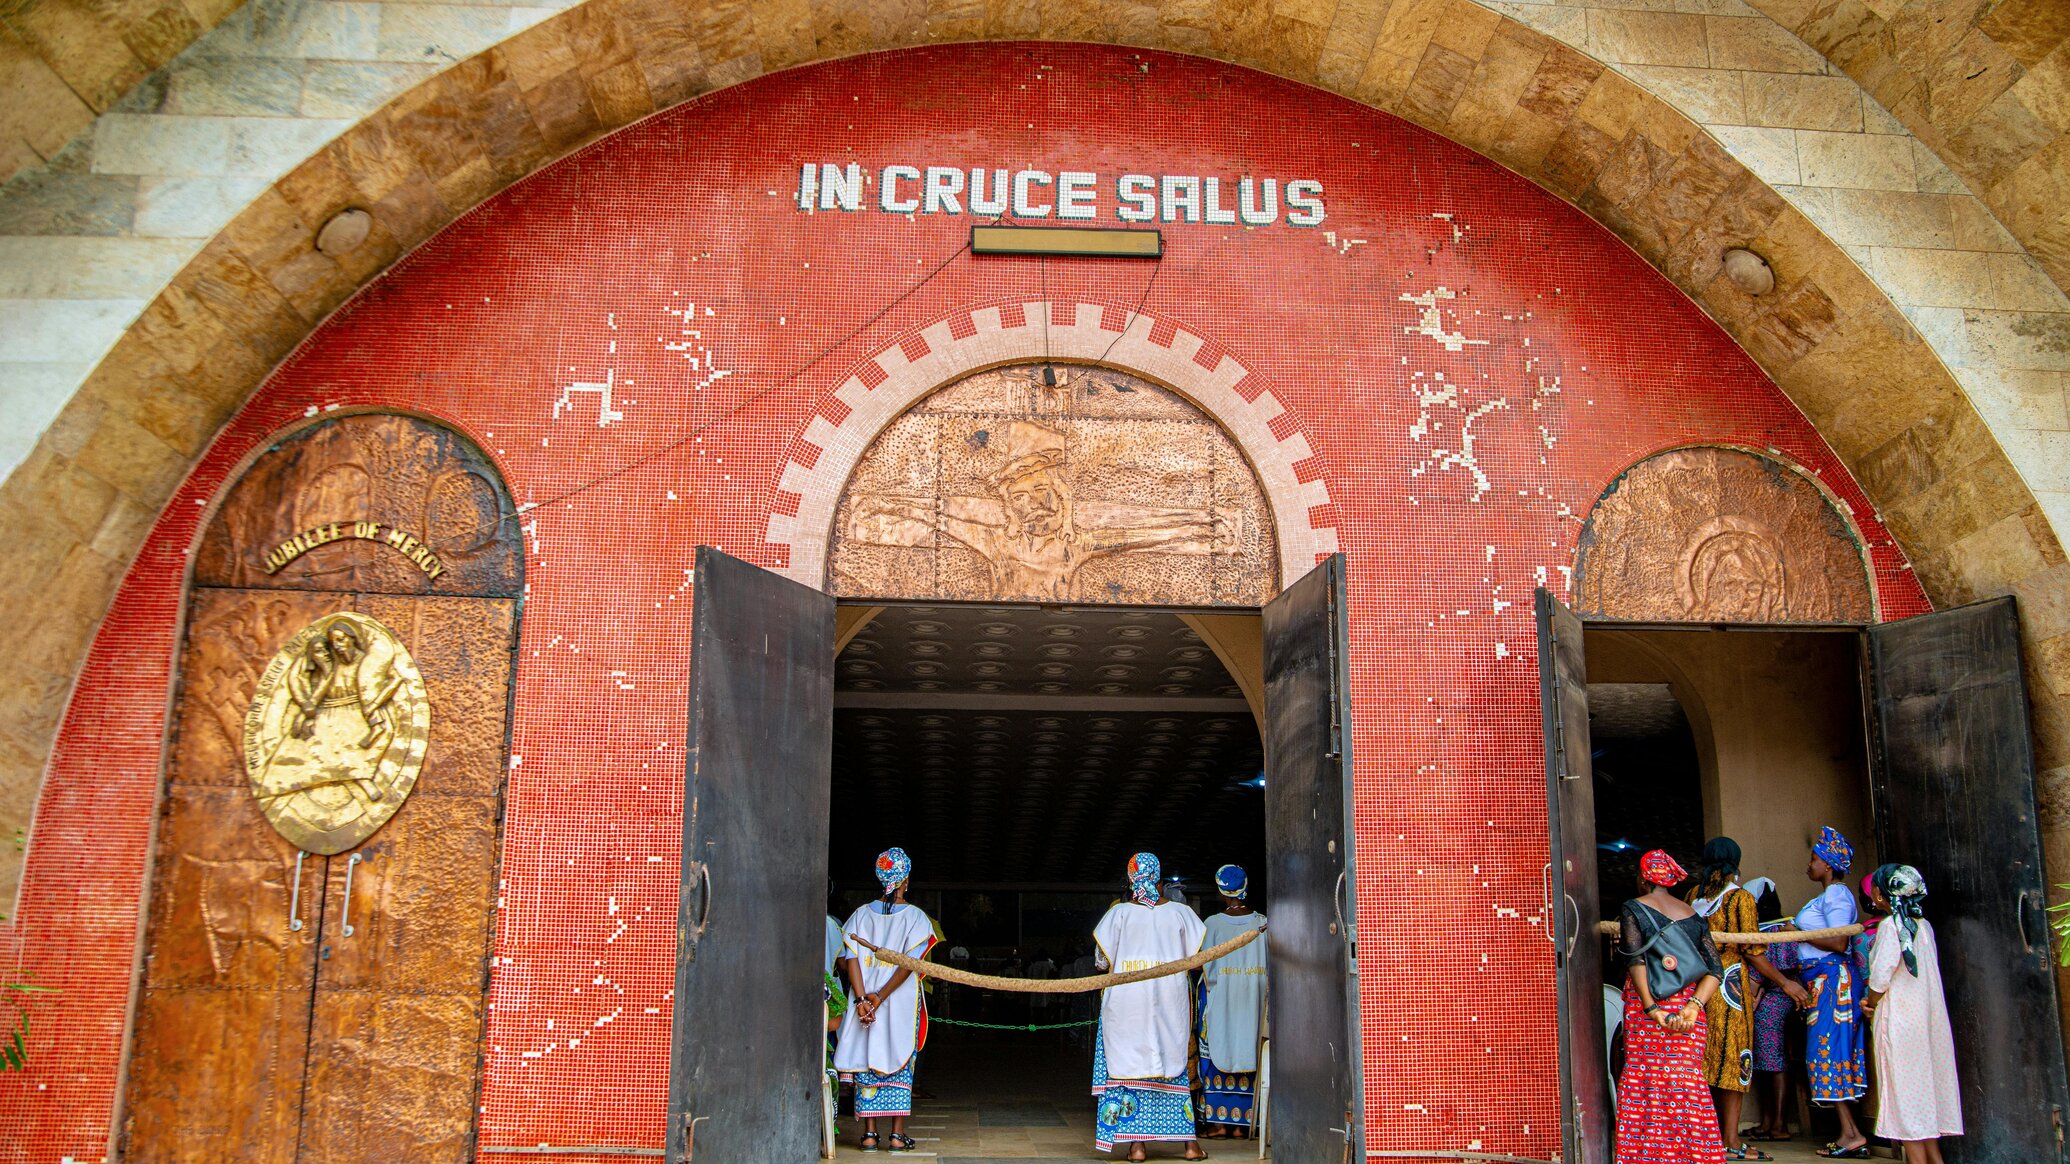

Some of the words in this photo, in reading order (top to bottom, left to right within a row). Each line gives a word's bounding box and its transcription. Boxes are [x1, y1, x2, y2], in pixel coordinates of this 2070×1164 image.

[799, 163, 862, 211] IN
[879, 165, 1097, 219] CRUCE
[1116, 175, 1325, 227] SALUS
[264, 523, 341, 575] JUBILEE
[354, 521, 381, 539] OF
[387, 528, 446, 580] MERCY
